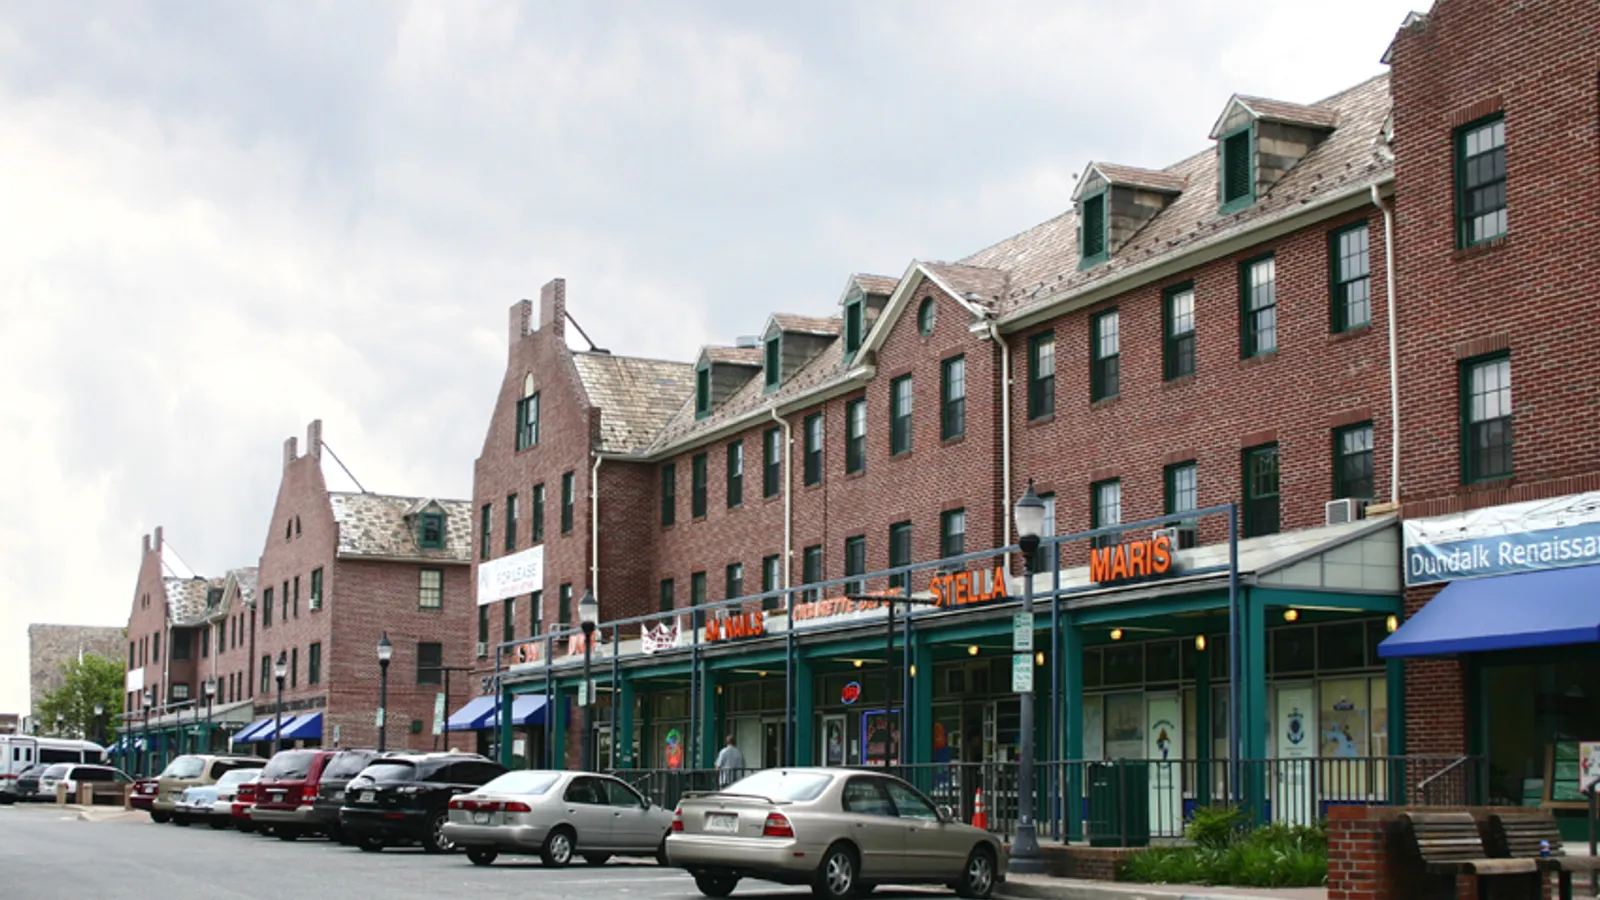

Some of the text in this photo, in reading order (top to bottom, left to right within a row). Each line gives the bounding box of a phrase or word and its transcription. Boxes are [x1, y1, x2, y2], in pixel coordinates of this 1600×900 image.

[512, 562, 537, 583] LEASE
[929, 536, 1172, 607] STELLA MARIS
[1411, 536, 1600, 576] Dundalk Renaissa
[724, 611, 764, 639] NAILS
